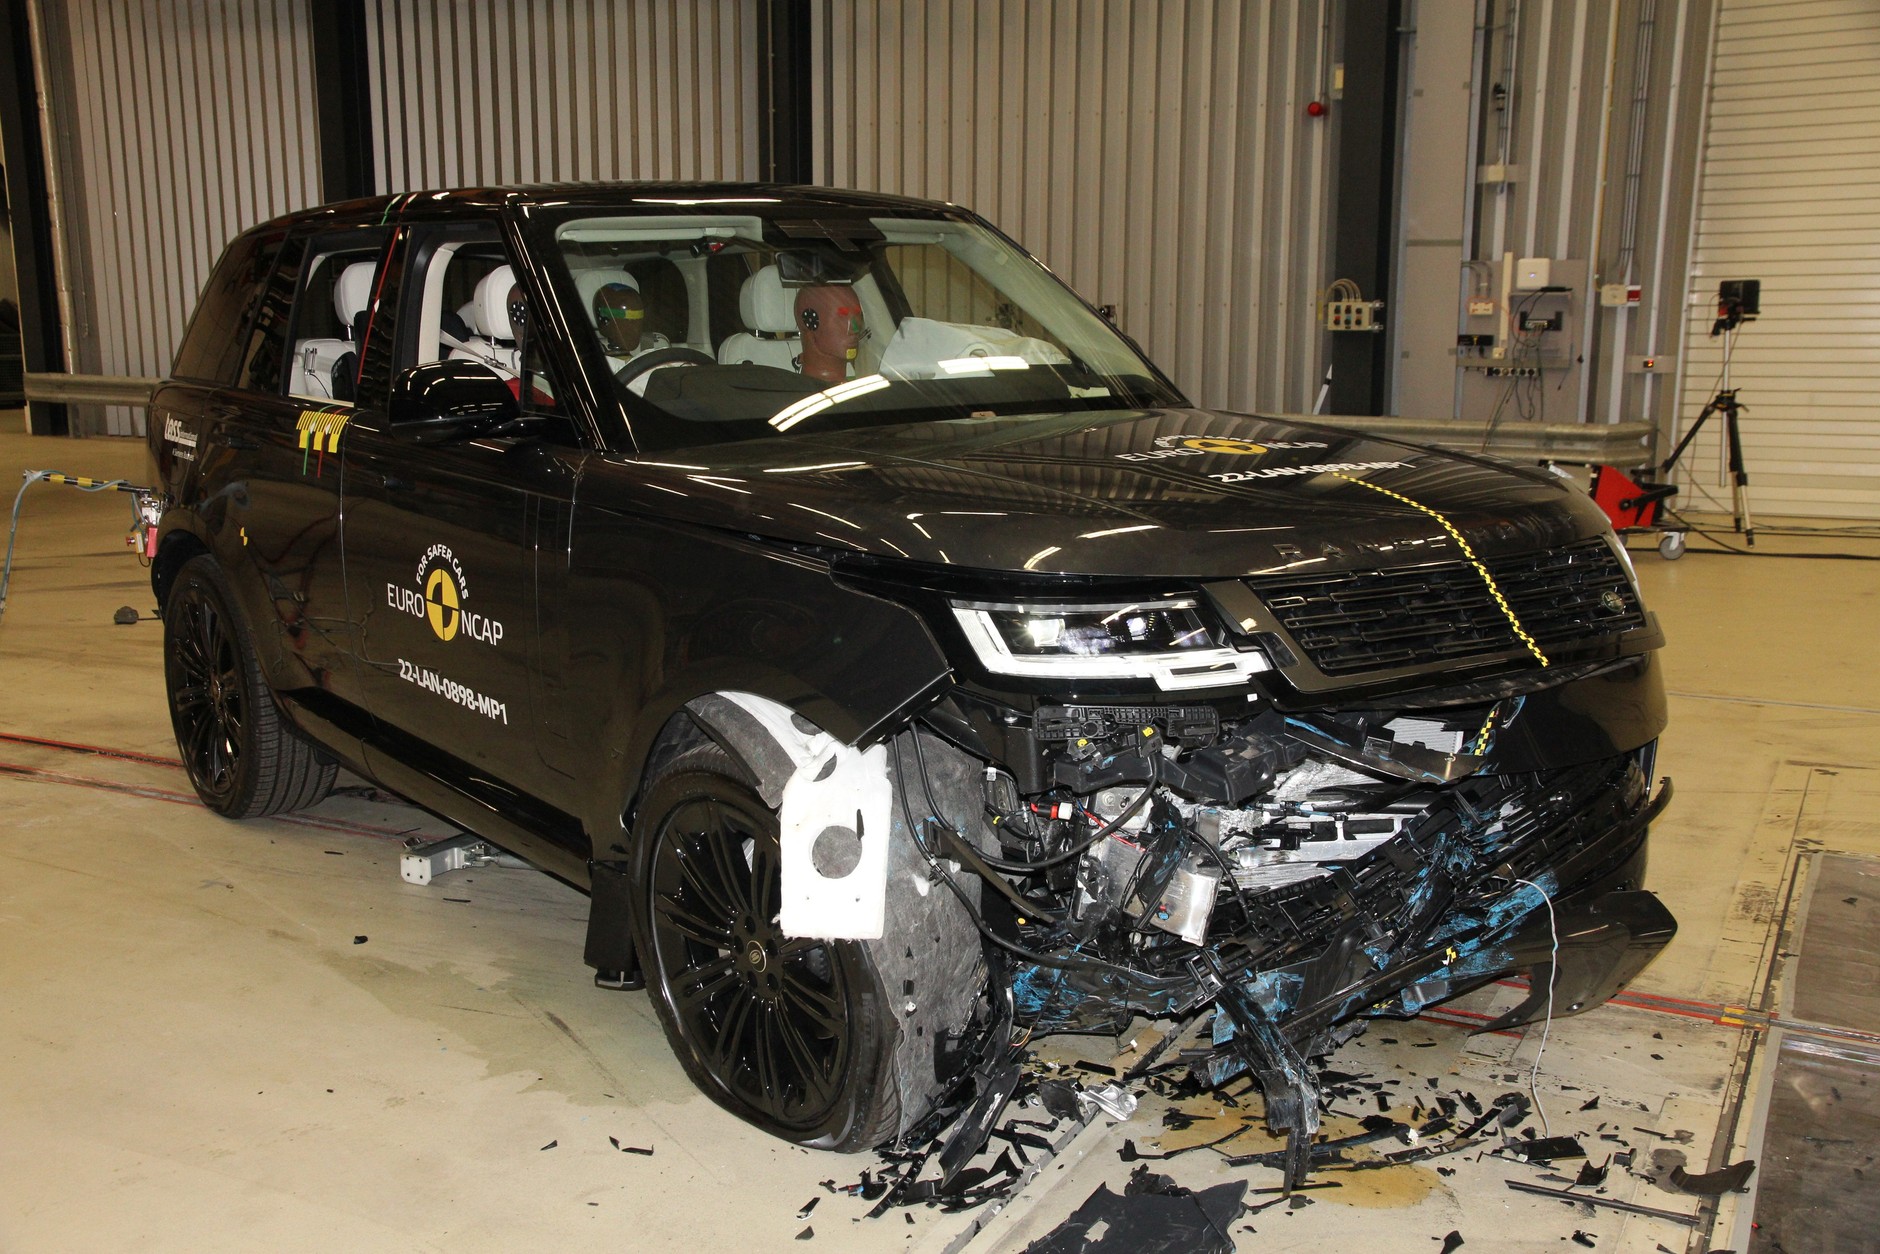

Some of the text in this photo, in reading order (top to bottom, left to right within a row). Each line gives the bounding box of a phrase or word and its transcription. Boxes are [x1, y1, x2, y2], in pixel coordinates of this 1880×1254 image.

[1115, 448, 1205, 461] EURO
[416, 544, 469, 600] FOR SAFER CARS
[387, 583, 503, 646] EURO NCAP
[398, 658, 507, 725] 22-LAN-0898-MP1
